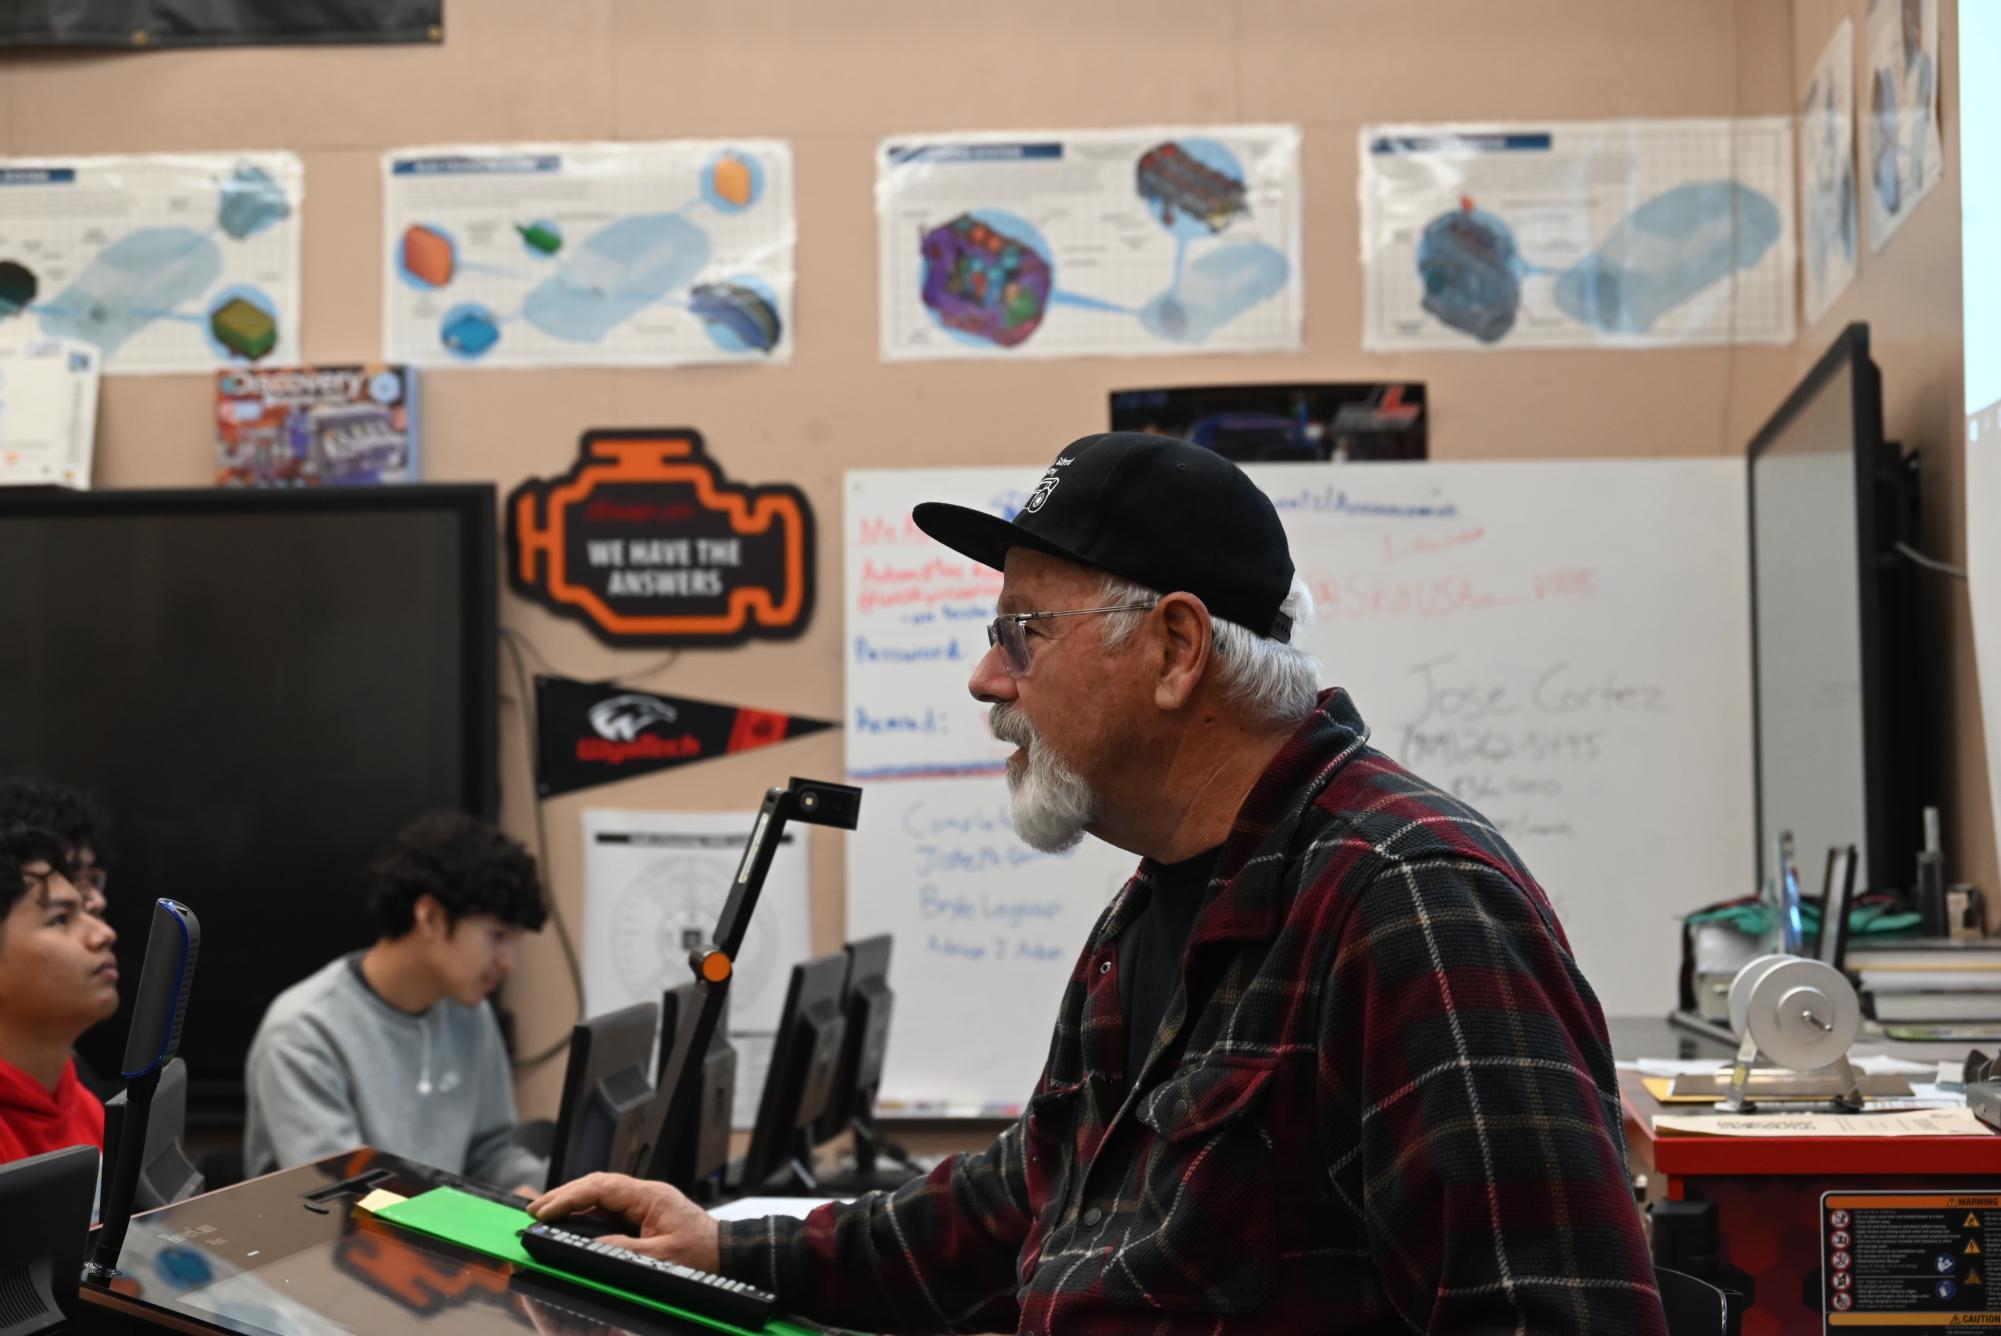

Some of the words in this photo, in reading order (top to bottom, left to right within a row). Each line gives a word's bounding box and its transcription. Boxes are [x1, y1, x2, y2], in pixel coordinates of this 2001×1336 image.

[227, 368, 364, 401] Discovery
[586, 538, 624, 567] WE
[628, 538, 691, 567] HAVE
[695, 538, 742, 567] THE
[607, 569, 723, 597] ANSWERS
[1406, 651, 1520, 724] Jose
[1534, 660, 1671, 715] Cortez
[1958, 1197, 1998, 1206] WARNING
[1962, 1314, 2001, 1324] CAUTION
